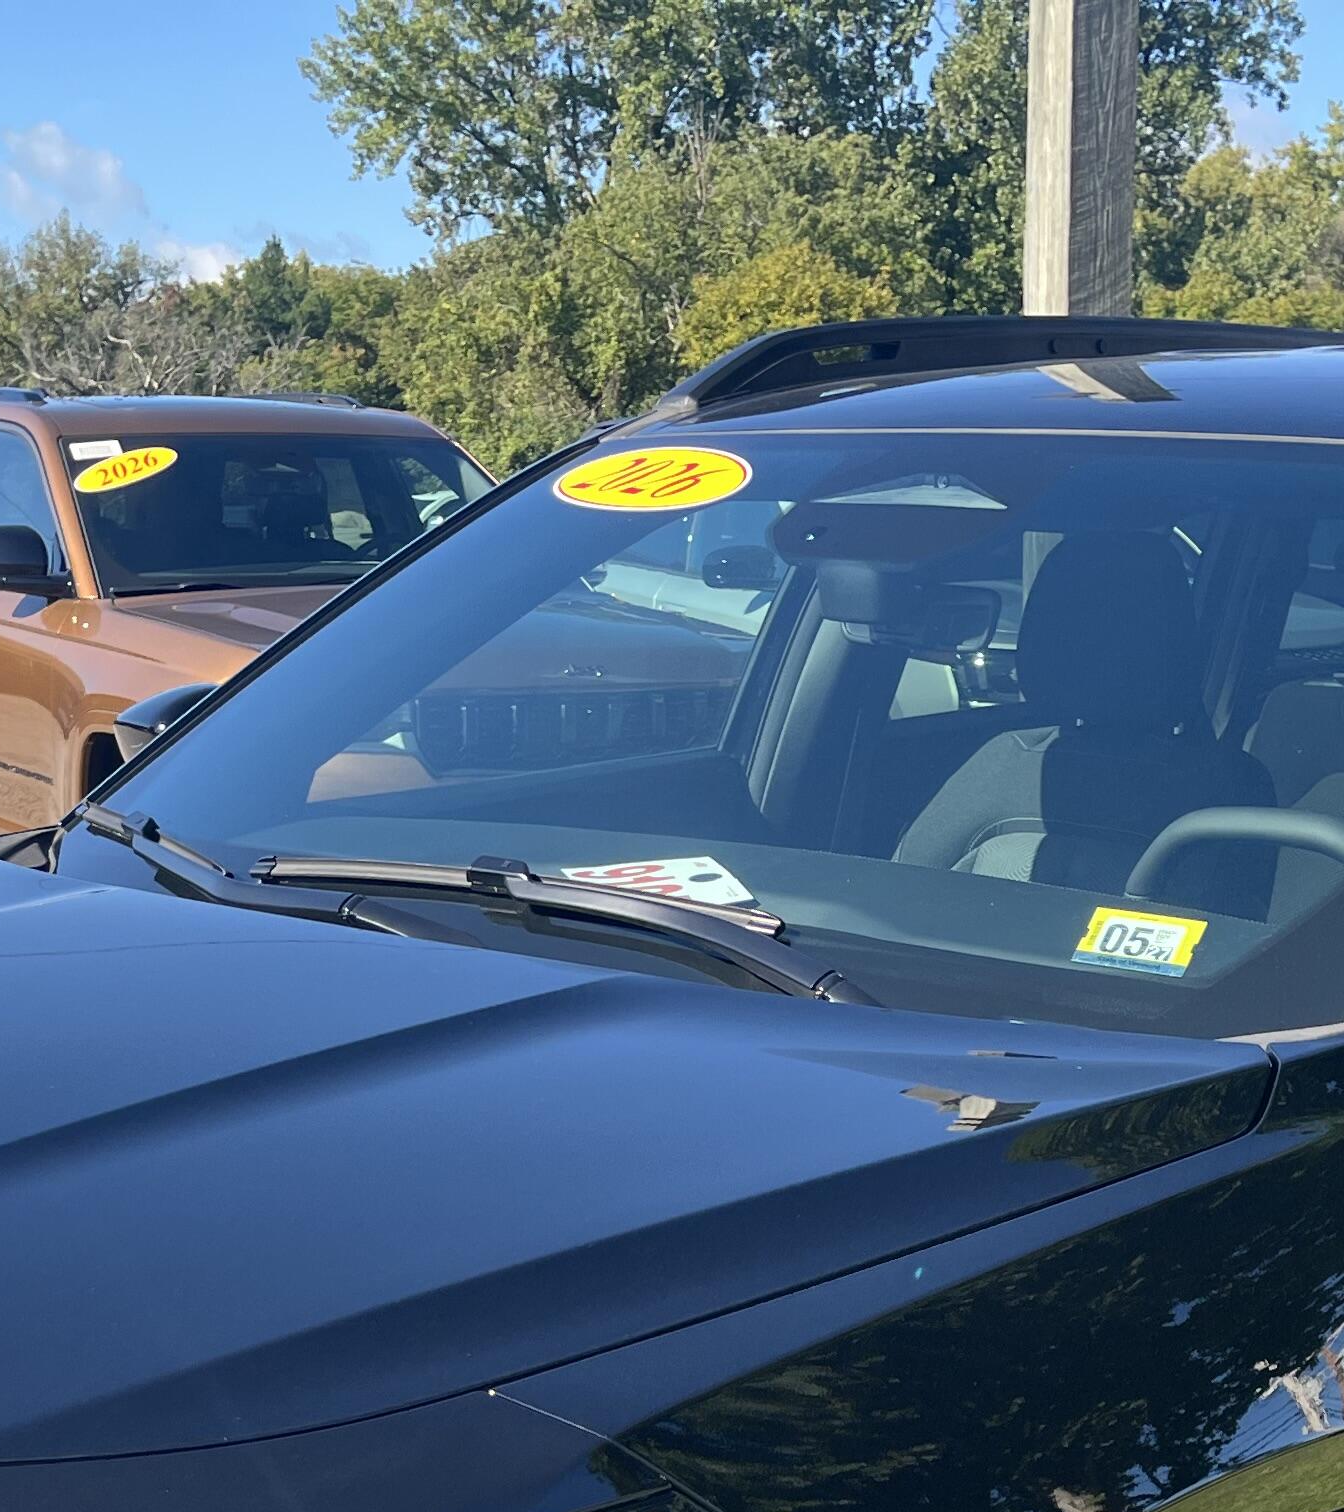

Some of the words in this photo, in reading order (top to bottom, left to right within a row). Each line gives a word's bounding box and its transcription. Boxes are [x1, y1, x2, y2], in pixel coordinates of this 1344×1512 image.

[96, 450, 158, 486] 2026
[570, 457, 732, 498] 2026
[1099, 923, 1155, 957] 05
